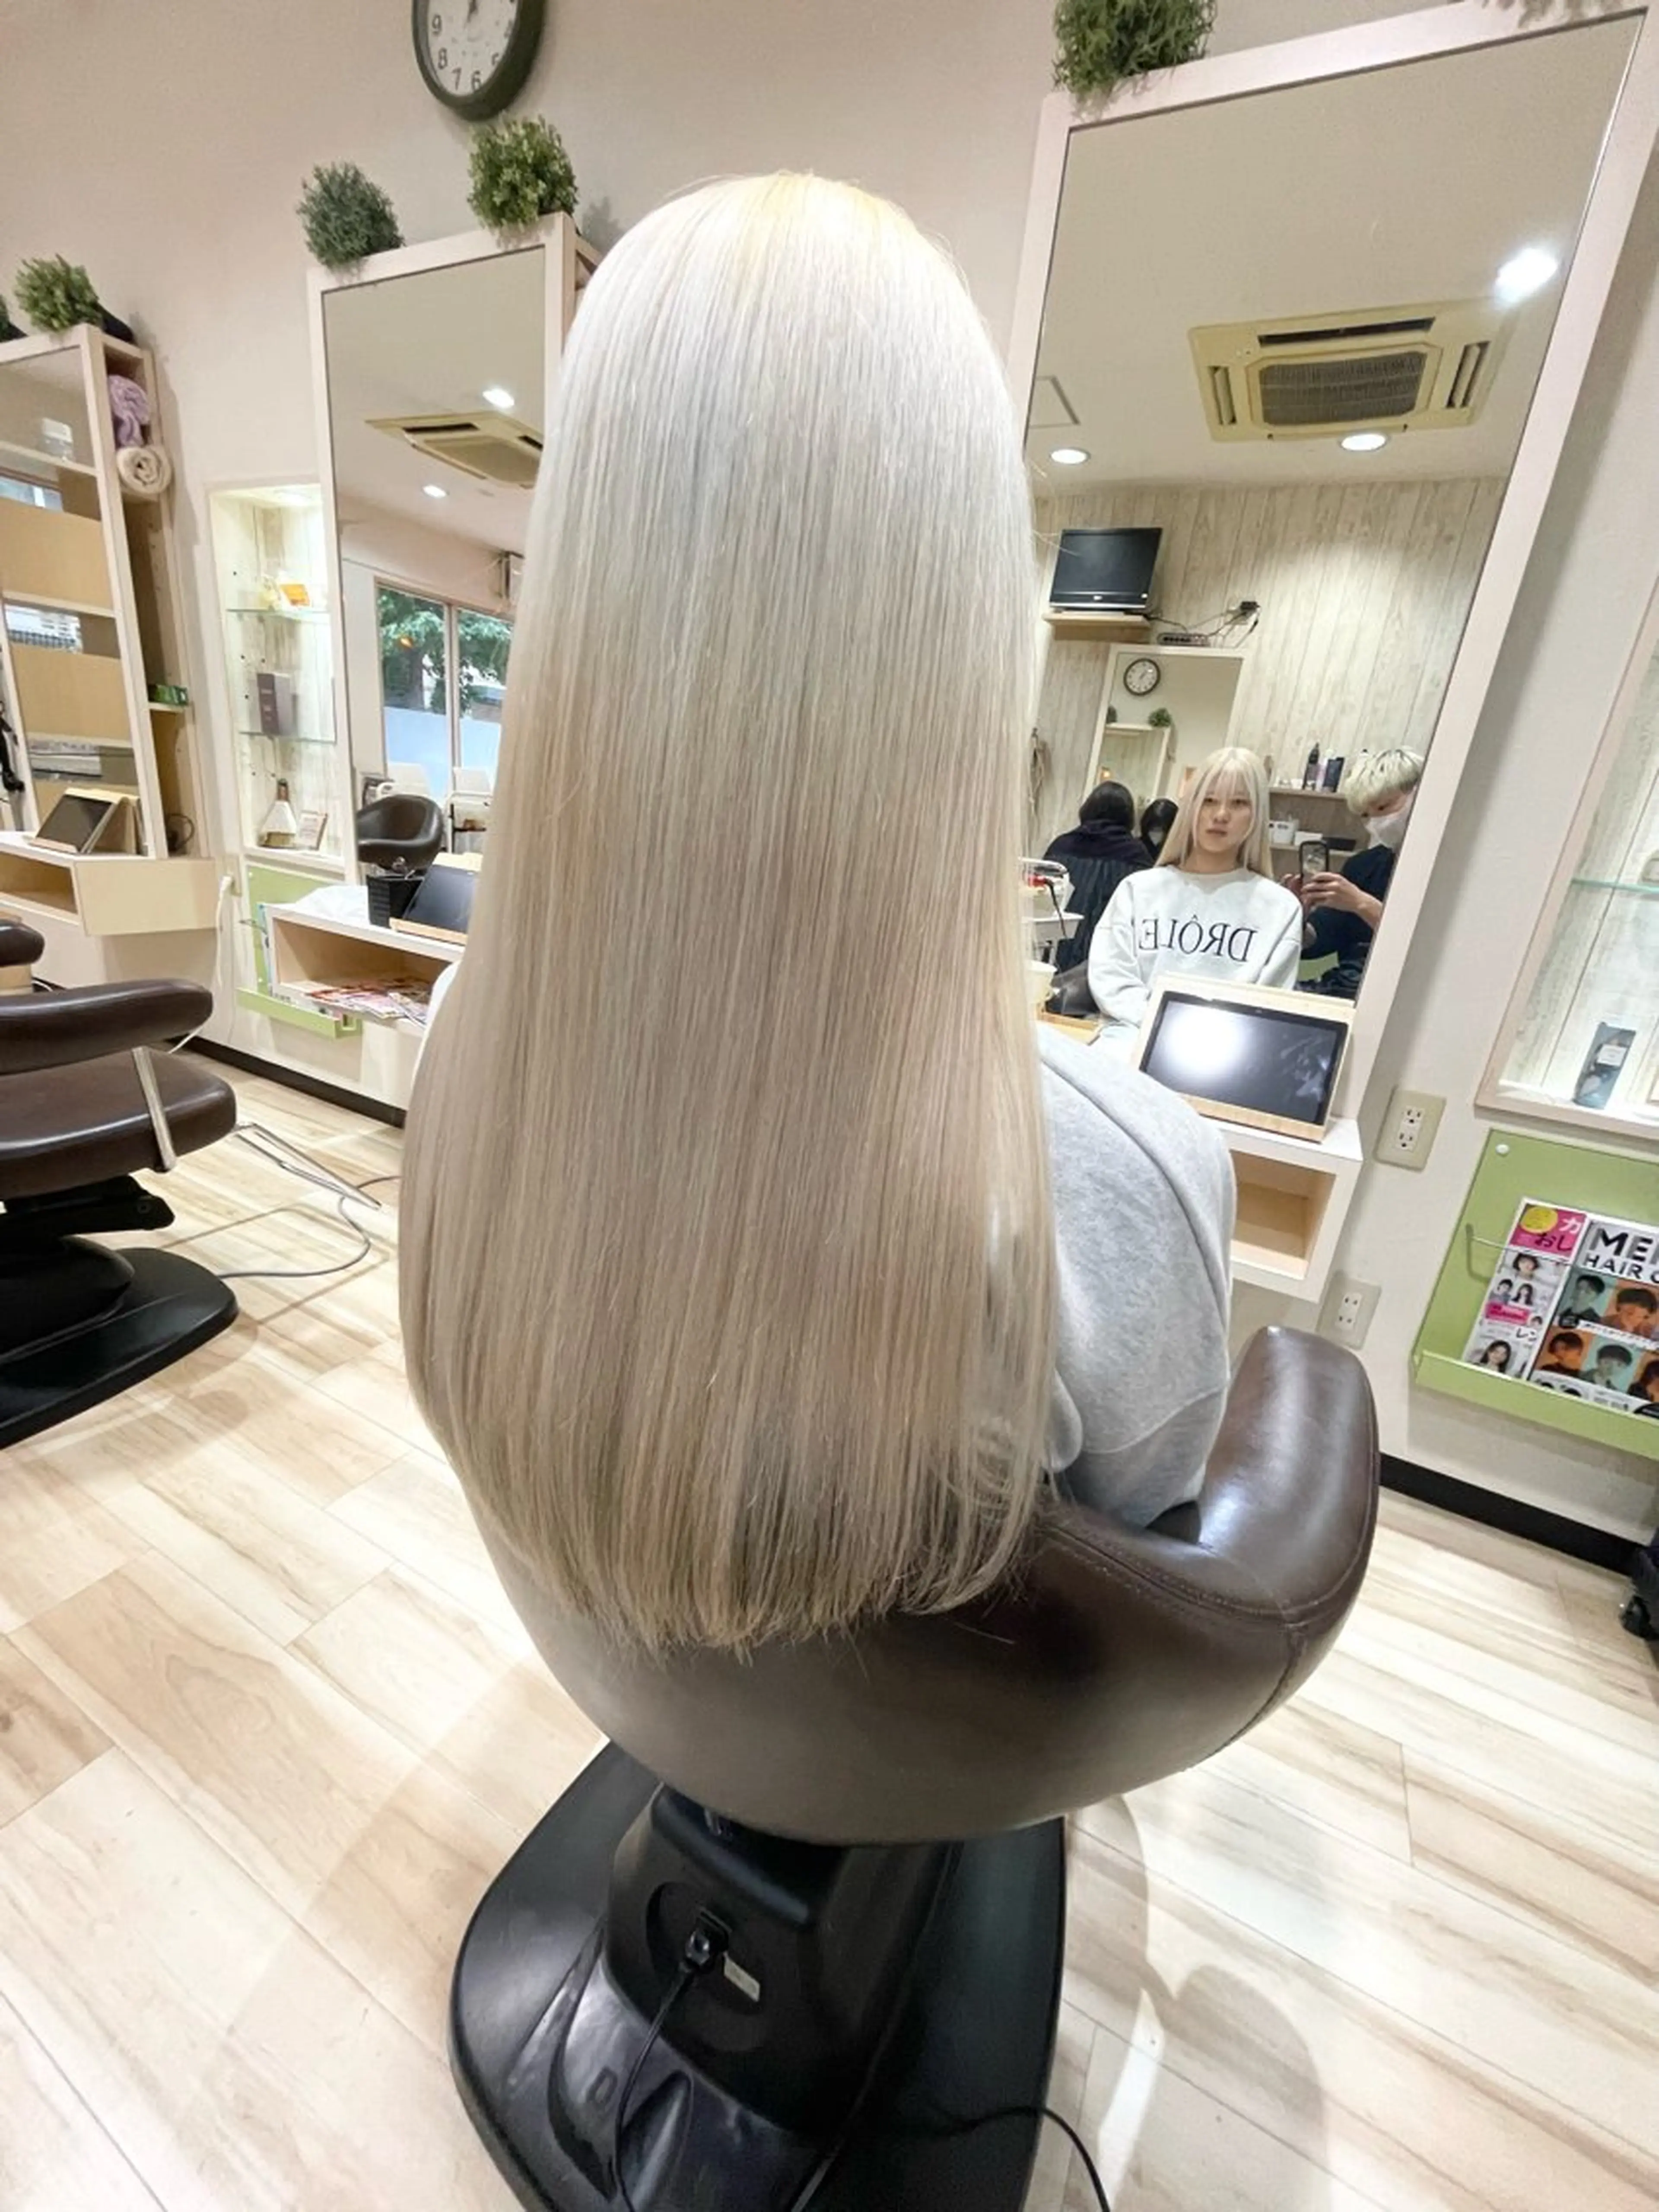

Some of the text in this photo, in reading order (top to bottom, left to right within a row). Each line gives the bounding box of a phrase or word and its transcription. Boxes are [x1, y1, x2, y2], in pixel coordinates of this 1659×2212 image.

[432, 14, 442, 36] 9
[438, 48, 448, 70] 8
[451, 67, 461, 90] 7
[471, 70, 481, 91] 6
[1583, 1254, 1643, 1279] HAIR
